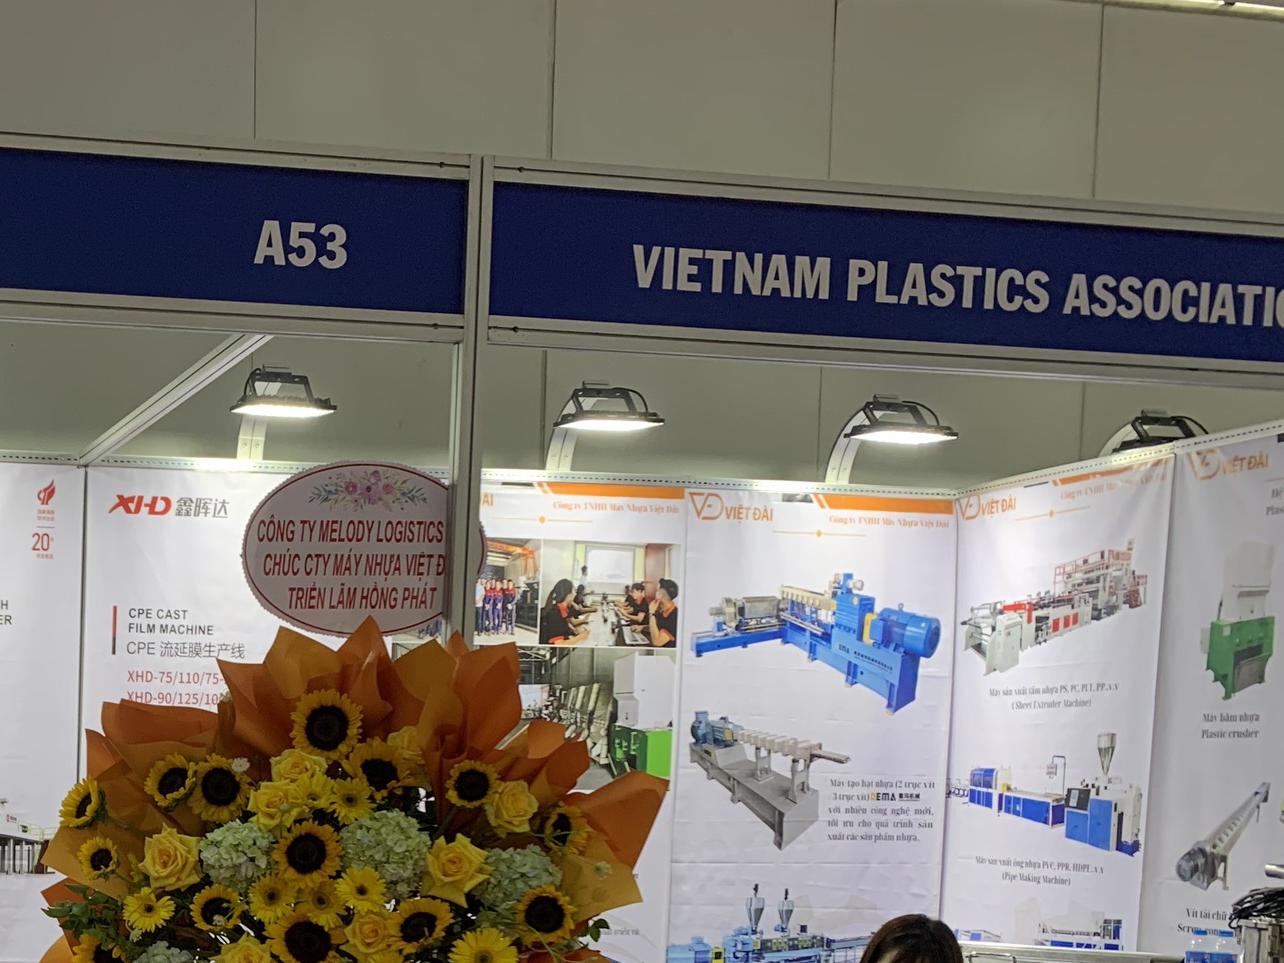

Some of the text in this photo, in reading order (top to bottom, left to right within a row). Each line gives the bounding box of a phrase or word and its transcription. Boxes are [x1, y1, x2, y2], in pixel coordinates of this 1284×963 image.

[254, 219, 348, 269] A53
[633, 244, 831, 300] VIETNAM
[847, 259, 1049, 314] PLASTICS
[108, 494, 172, 515] XHD
[175, 496, 229, 518] 鑫晖达
[981, 497, 1016, 518] VIỆT ĐÀI
[725, 506, 773, 524] VIỆT ĐÀI
[258, 514, 444, 543] CÔNG TY MELODY LOGISTICS
[264, 548, 433, 581] CHÚC CTY MÁY NHỰA VIỆT
[288, 577, 437, 610] TRIỂN LÃM HỒNG PHÁT
[128, 607, 188, 620] CPE CAST
[128, 623, 214, 635] FILM MACHINE
[126, 641, 156, 655] CPE
[159, 641, 245, 659] 流延膜生产线
[127, 671, 224, 685] XHD-75/110/75-
[1201, 728, 1259, 740] Plastic crusher
[870, 805, 887, 816] công
[858, 819, 872, 828] cho
